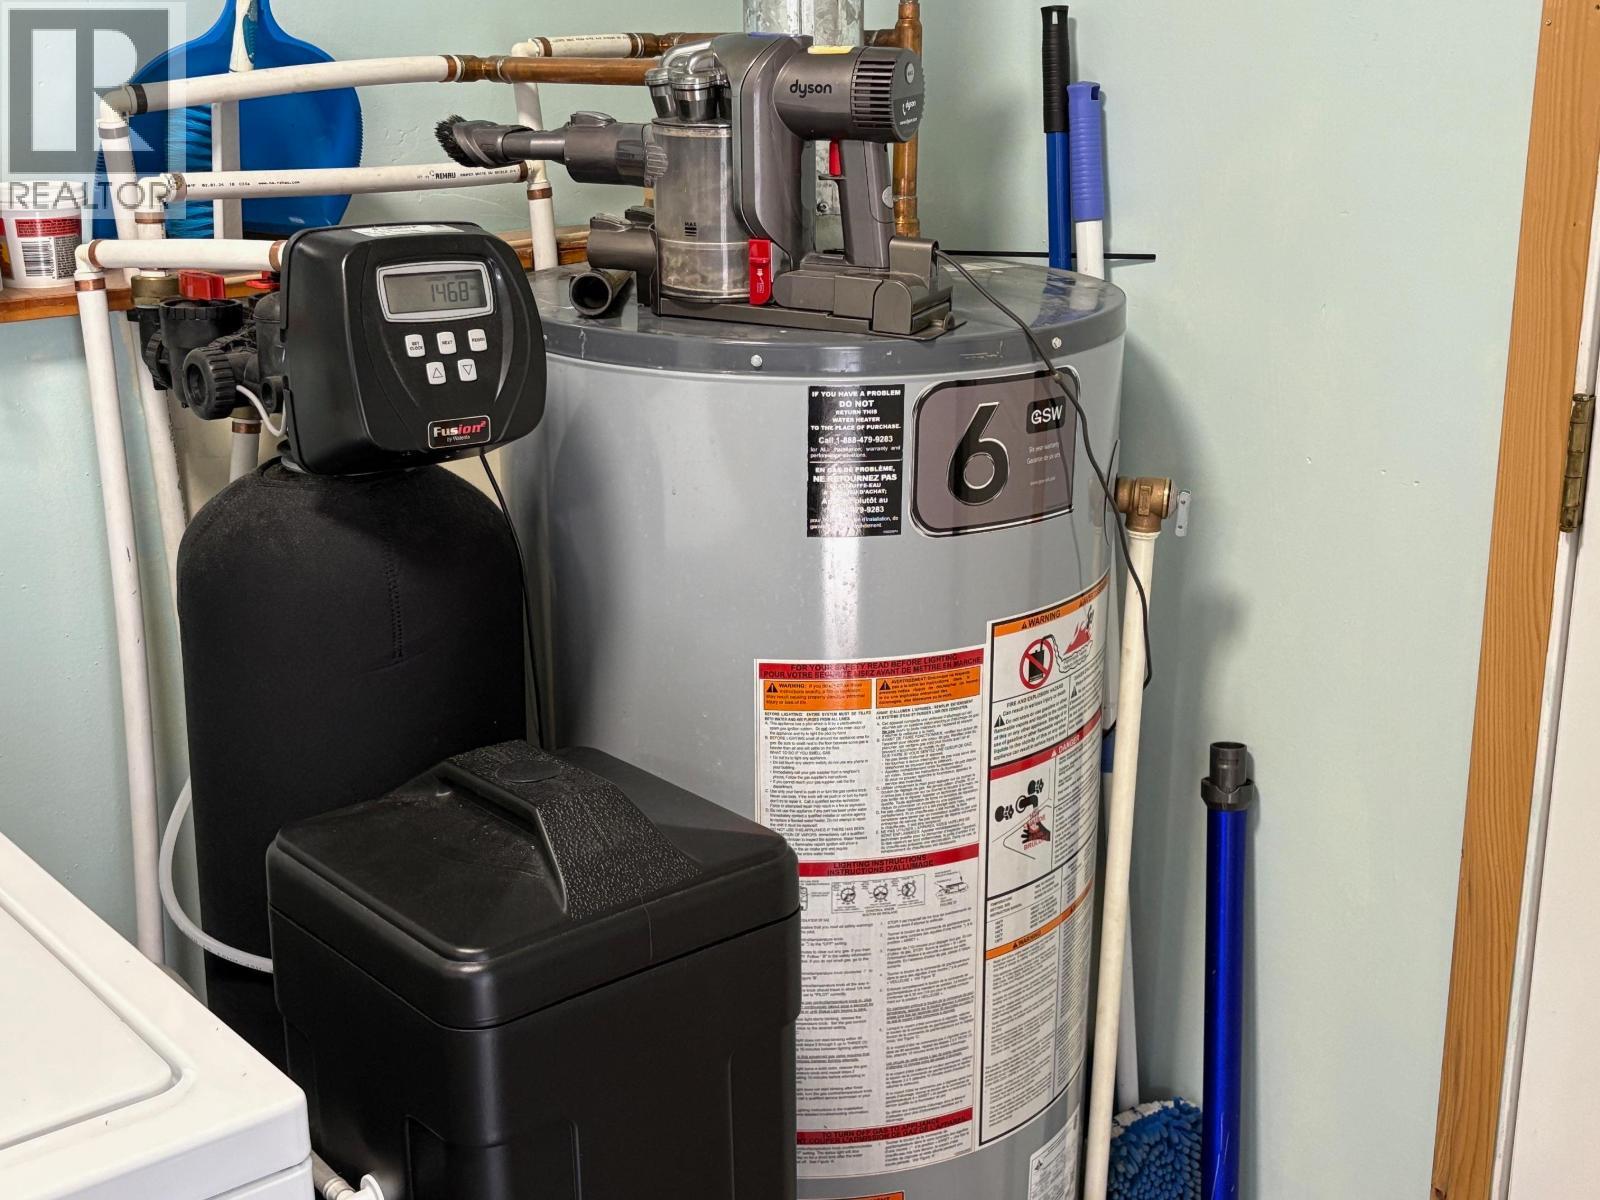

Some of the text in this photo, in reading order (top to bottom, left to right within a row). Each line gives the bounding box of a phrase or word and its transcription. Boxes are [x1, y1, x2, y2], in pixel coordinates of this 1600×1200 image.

[789, 80, 832, 99] dyson
[435, 172, 456, 180] REHAU
[431, 281, 470, 303] 1468
[839, 399, 875, 408] DO NOT
[1031, 405, 1064, 425] GSW
[818, 436, 834, 444] Call
[947, 401, 1010, 507] 6
[813, 475, 825, 483] NE
[881, 473, 898, 481] PAS
[1029, 609, 1061, 628] WARNING
[867, 661, 889, 669] READ
[891, 658, 922, 668] BEFORE
[923, 654, 958, 664] LIGHTING
[876, 668, 900, 676] AVANT
[901, 666, 912, 674] DE
[912, 664, 942, 673] METTRE
[942, 662, 953, 670] EN
[953, 657, 982, 667] MARCHE
[1058, 734, 1080, 754] DANGER
[827, 859, 934, 876] INSTRUCTIONS D'ALLUMAGE
[833, 855, 927, 869] LIGHTING INSTRUCTIONS
[889, 1126, 900, 1134] TO
[806, 1137, 840, 1145] COUPER
